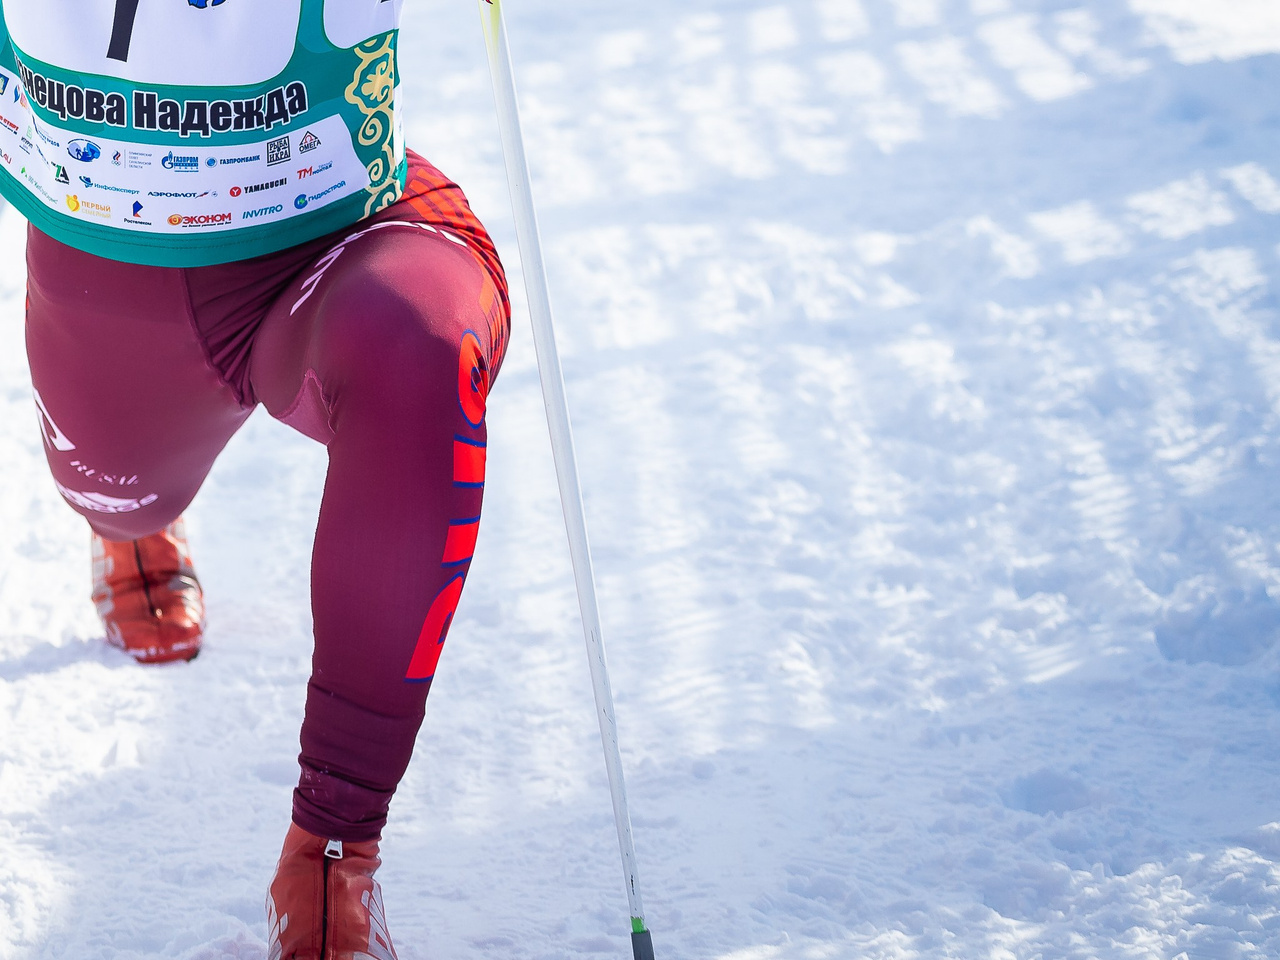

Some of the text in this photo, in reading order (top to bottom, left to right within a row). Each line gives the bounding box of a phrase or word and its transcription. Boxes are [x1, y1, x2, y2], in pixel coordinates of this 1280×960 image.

[134, 82, 308, 137] Надежда
[220, 154, 261, 165] ГАЗПРОМБАНК
[244, 178, 287, 194] YAMAGUCHI
[81, 200, 111, 213] ПЕРВЫЙ
[242, 204, 283, 219] INVITRO
[182, 212, 232, 225] ЭКОНОМ
